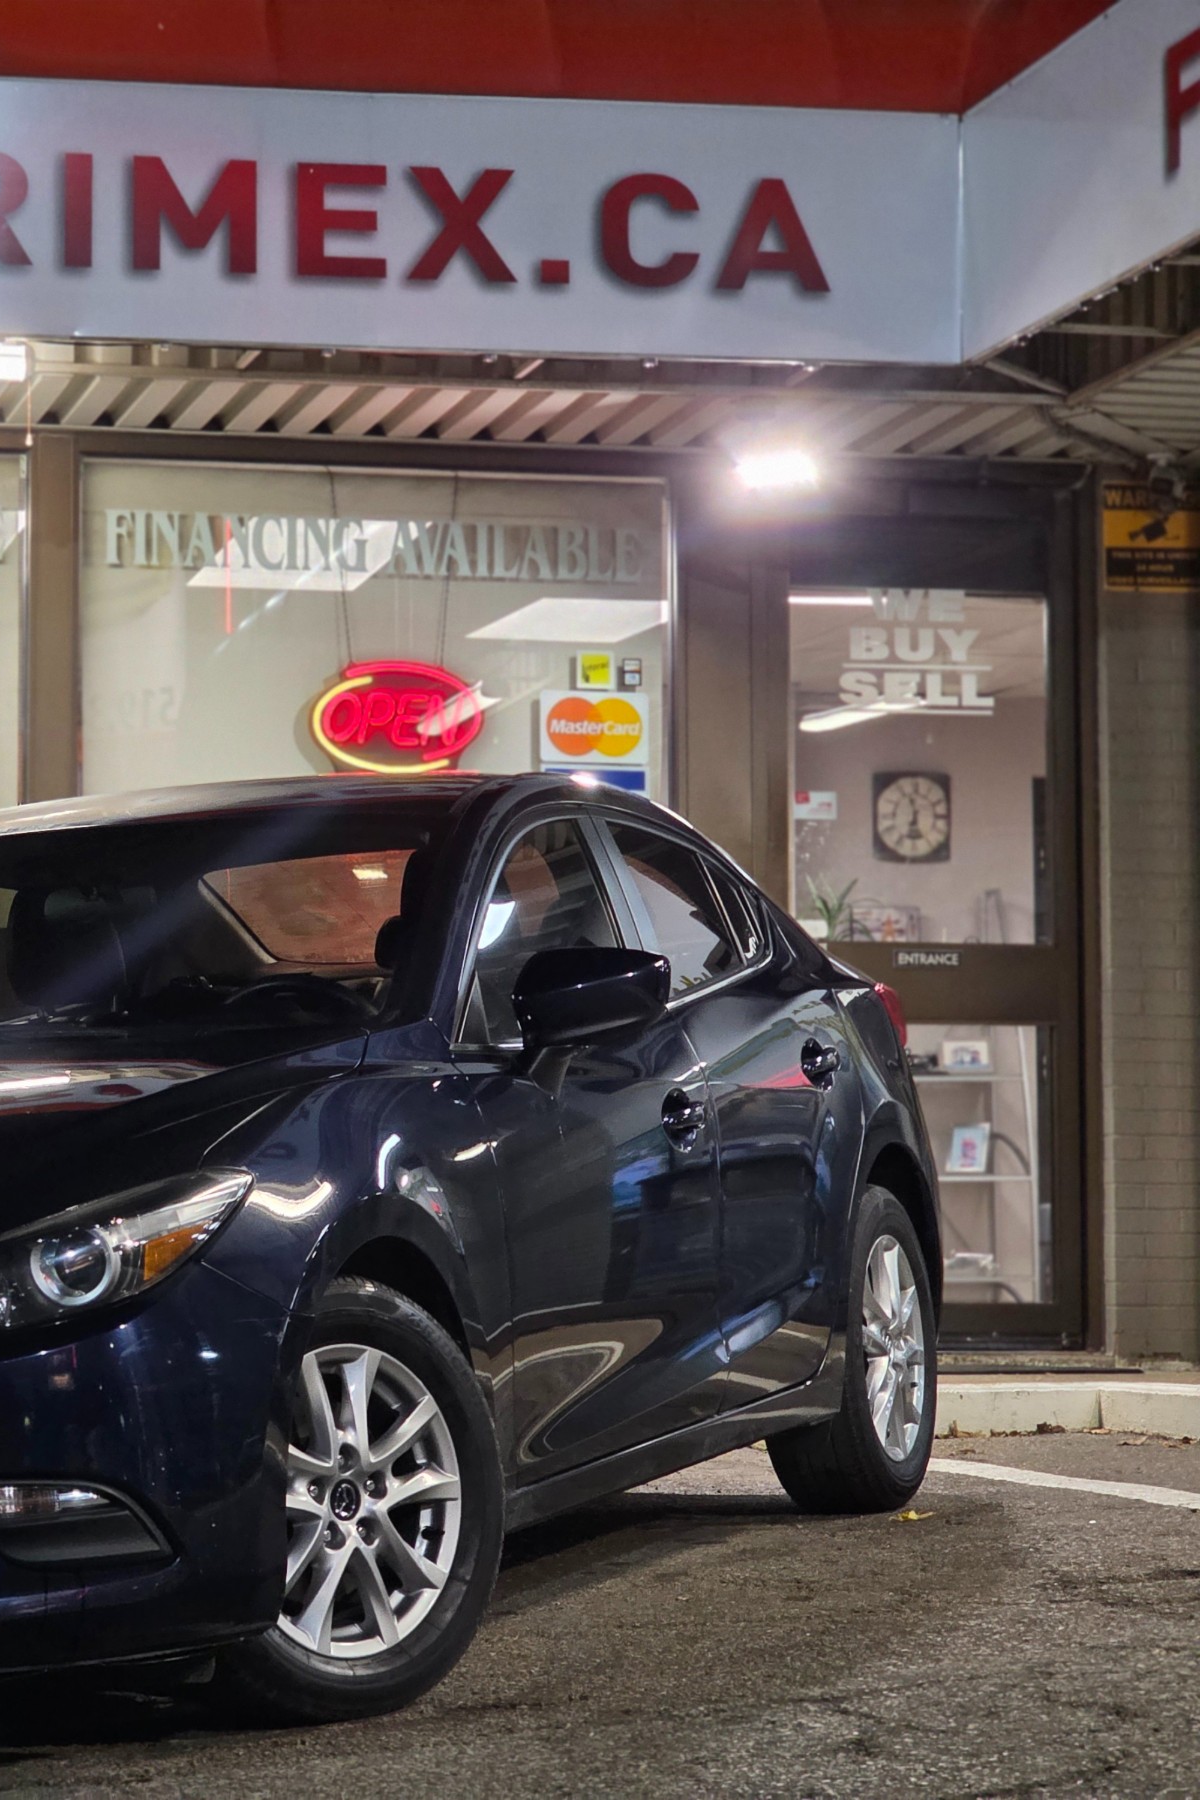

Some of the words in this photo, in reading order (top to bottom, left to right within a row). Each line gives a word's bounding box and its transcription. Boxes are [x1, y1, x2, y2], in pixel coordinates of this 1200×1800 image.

[104, 509, 368, 572] FINANCING
[385, 518, 644, 583] AVAILABLE
[866, 588, 967, 622] WE
[849, 626, 981, 662] BUY
[838, 670, 996, 708] SELL
[322, 691, 466, 746] OPEN
[549, 718, 641, 736] MasterCard
[897, 951, 960, 966] ENTRANCE
